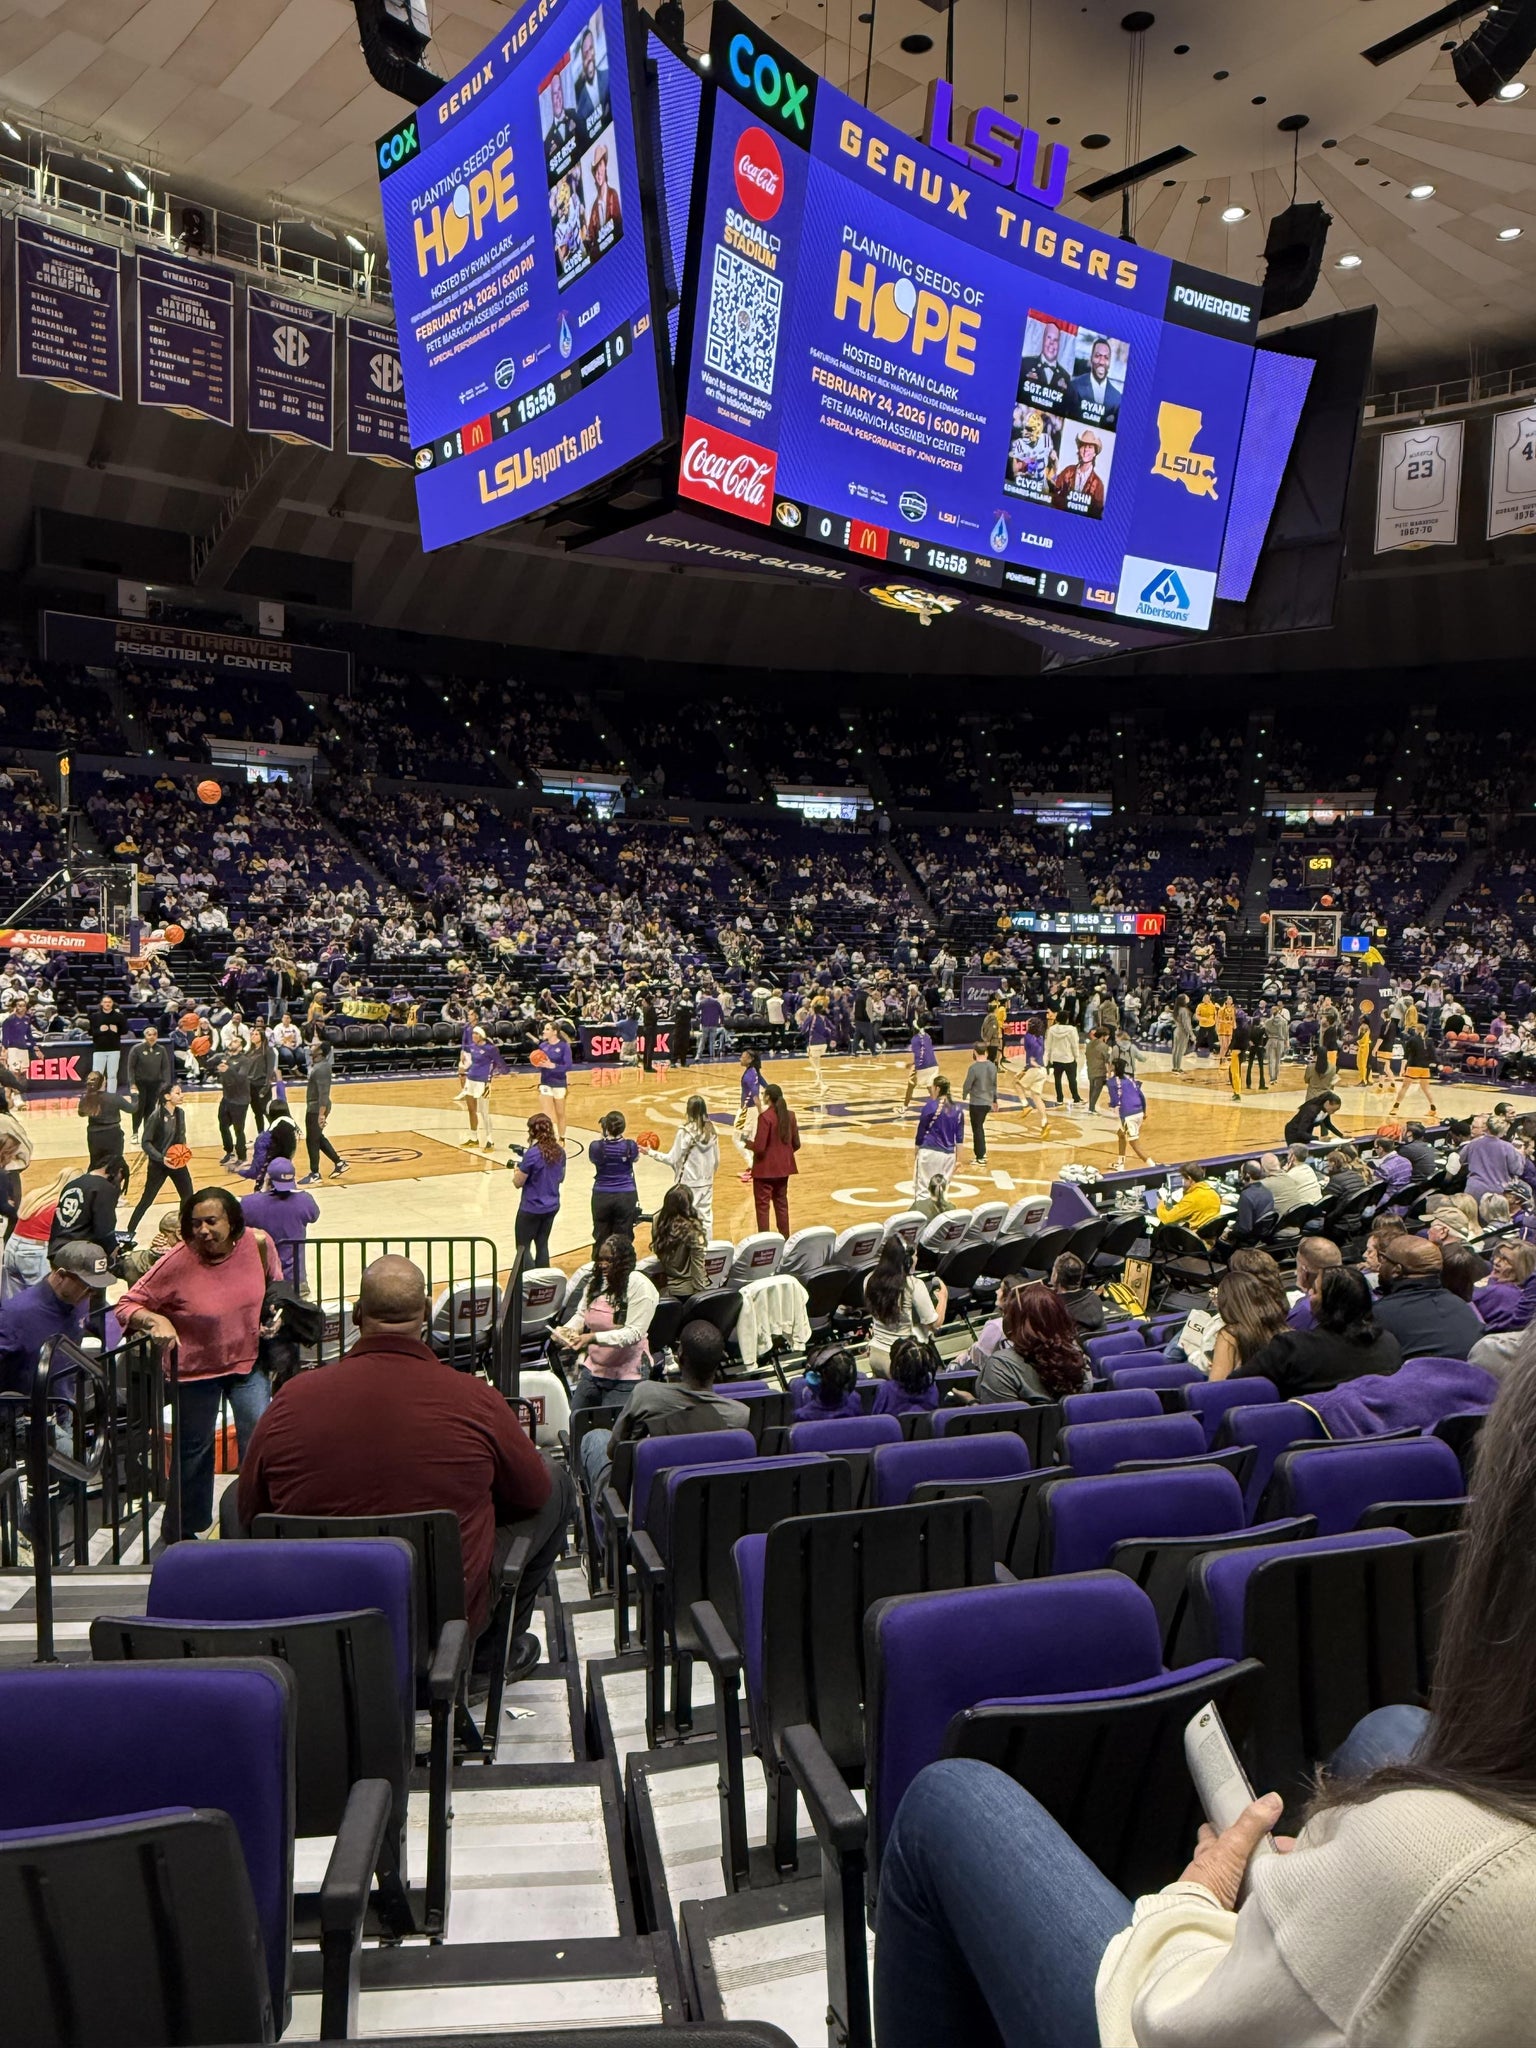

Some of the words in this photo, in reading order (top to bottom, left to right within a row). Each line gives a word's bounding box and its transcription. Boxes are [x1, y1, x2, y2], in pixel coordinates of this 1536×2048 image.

[438, 62, 494, 124] GEAUX
[730, 34, 808, 130] COX
[379, 122, 418, 170] COX
[922, 77, 1070, 209] LSU
[411, 166, 463, 216] PLANTING
[463, 142, 497, 177] SEEDS
[497, 124, 511, 152] OF
[414, 147, 519, 278] HOPE
[840, 120, 970, 220] GEAUX
[996, 206, 1139, 290] TIGERS
[726, 208, 770, 243] SOCIAL
[430, 272, 460, 299] HOSTED
[460, 265, 470, 282] BY
[471, 252, 491, 275] RYAN
[491, 234, 514, 260] CLARK
[724, 226, 777, 270] STADIUM
[843, 225, 913, 276] PLANTING
[916, 264, 960, 299] SEEDS
[963, 286, 985, 307] OF
[36, 271, 102, 299] CHAMPIONS
[42, 262, 96, 288] NATIONAL
[162, 270, 210, 290] GYMNASTICS
[162, 298, 211, 320] NATIONAL
[416, 305, 462, 342] FEBRUARY
[463, 298, 476, 316] 24,
[476, 282, 498, 306] 2026
[502, 264, 520, 289] 6:00
[520, 254, 535, 276] PM
[834, 249, 982, 376] HOPE
[1174, 285, 1252, 324] POWERADE
[156, 306, 217, 330] CHAMPIONS
[426, 336, 443, 354] PETE
[504, 281, 529, 306] CENTER
[616, 335, 625, 356] 0
[633, 314, 650, 339] LSU
[272, 325, 310, 367] SEC
[369, 353, 404, 393] SEC
[842, 342, 882, 371] HOSTED
[883, 360, 898, 376] BY
[898, 366, 925, 389] RYAN
[926, 378, 960, 401] CLARK
[366, 392, 407, 410] CHAMPION
[502, 418, 510, 433] 1
[518, 382, 557, 423] 15:58
[812, 366, 876, 406] FEBRUARY
[876, 395, 894, 418] 24,
[896, 402, 926, 426] 2026
[934, 416, 959, 438] 6:00
[961, 425, 980, 444] PM
[1080, 399, 1106, 416] RYAN
[821, 394, 843, 413] PETE
[844, 402, 888, 430] MARAVICH
[888, 418, 934, 446] ASSEMBLY
[932, 437, 966, 458] CENTER
[826, 416, 854, 437] SPECIAL
[443, 441, 453, 458] 0
[1161, 452, 1201, 476] LSU
[1522, 442, 1536, 460] 4
[684, 437, 773, 505] Coca-Cola
[1016, 476, 1044, 492] CLYDE
[1407, 460, 1434, 480] 23
[1066, 490, 1092, 506] JOHN
[820, 518, 832, 537] 0
[938, 511, 957, 526] LSU
[645, 532, 757, 562] VENTURE
[758, 556, 848, 580] GLOBAL
[904, 549, 912, 562] 1
[928, 548, 968, 575] 15:58
[1056, 580, 1069, 598] 0
[1086, 587, 1116, 606] LSU
[1136, 602, 1189, 622] Albertsons
[115, 640, 218, 664] ASSEMBLY
[223, 654, 292, 674] CENTER
[116, 622, 175, 646] PETE
[182, 632, 293, 659] MARAVICH
[26, 1055, 82, 1081] EEK
